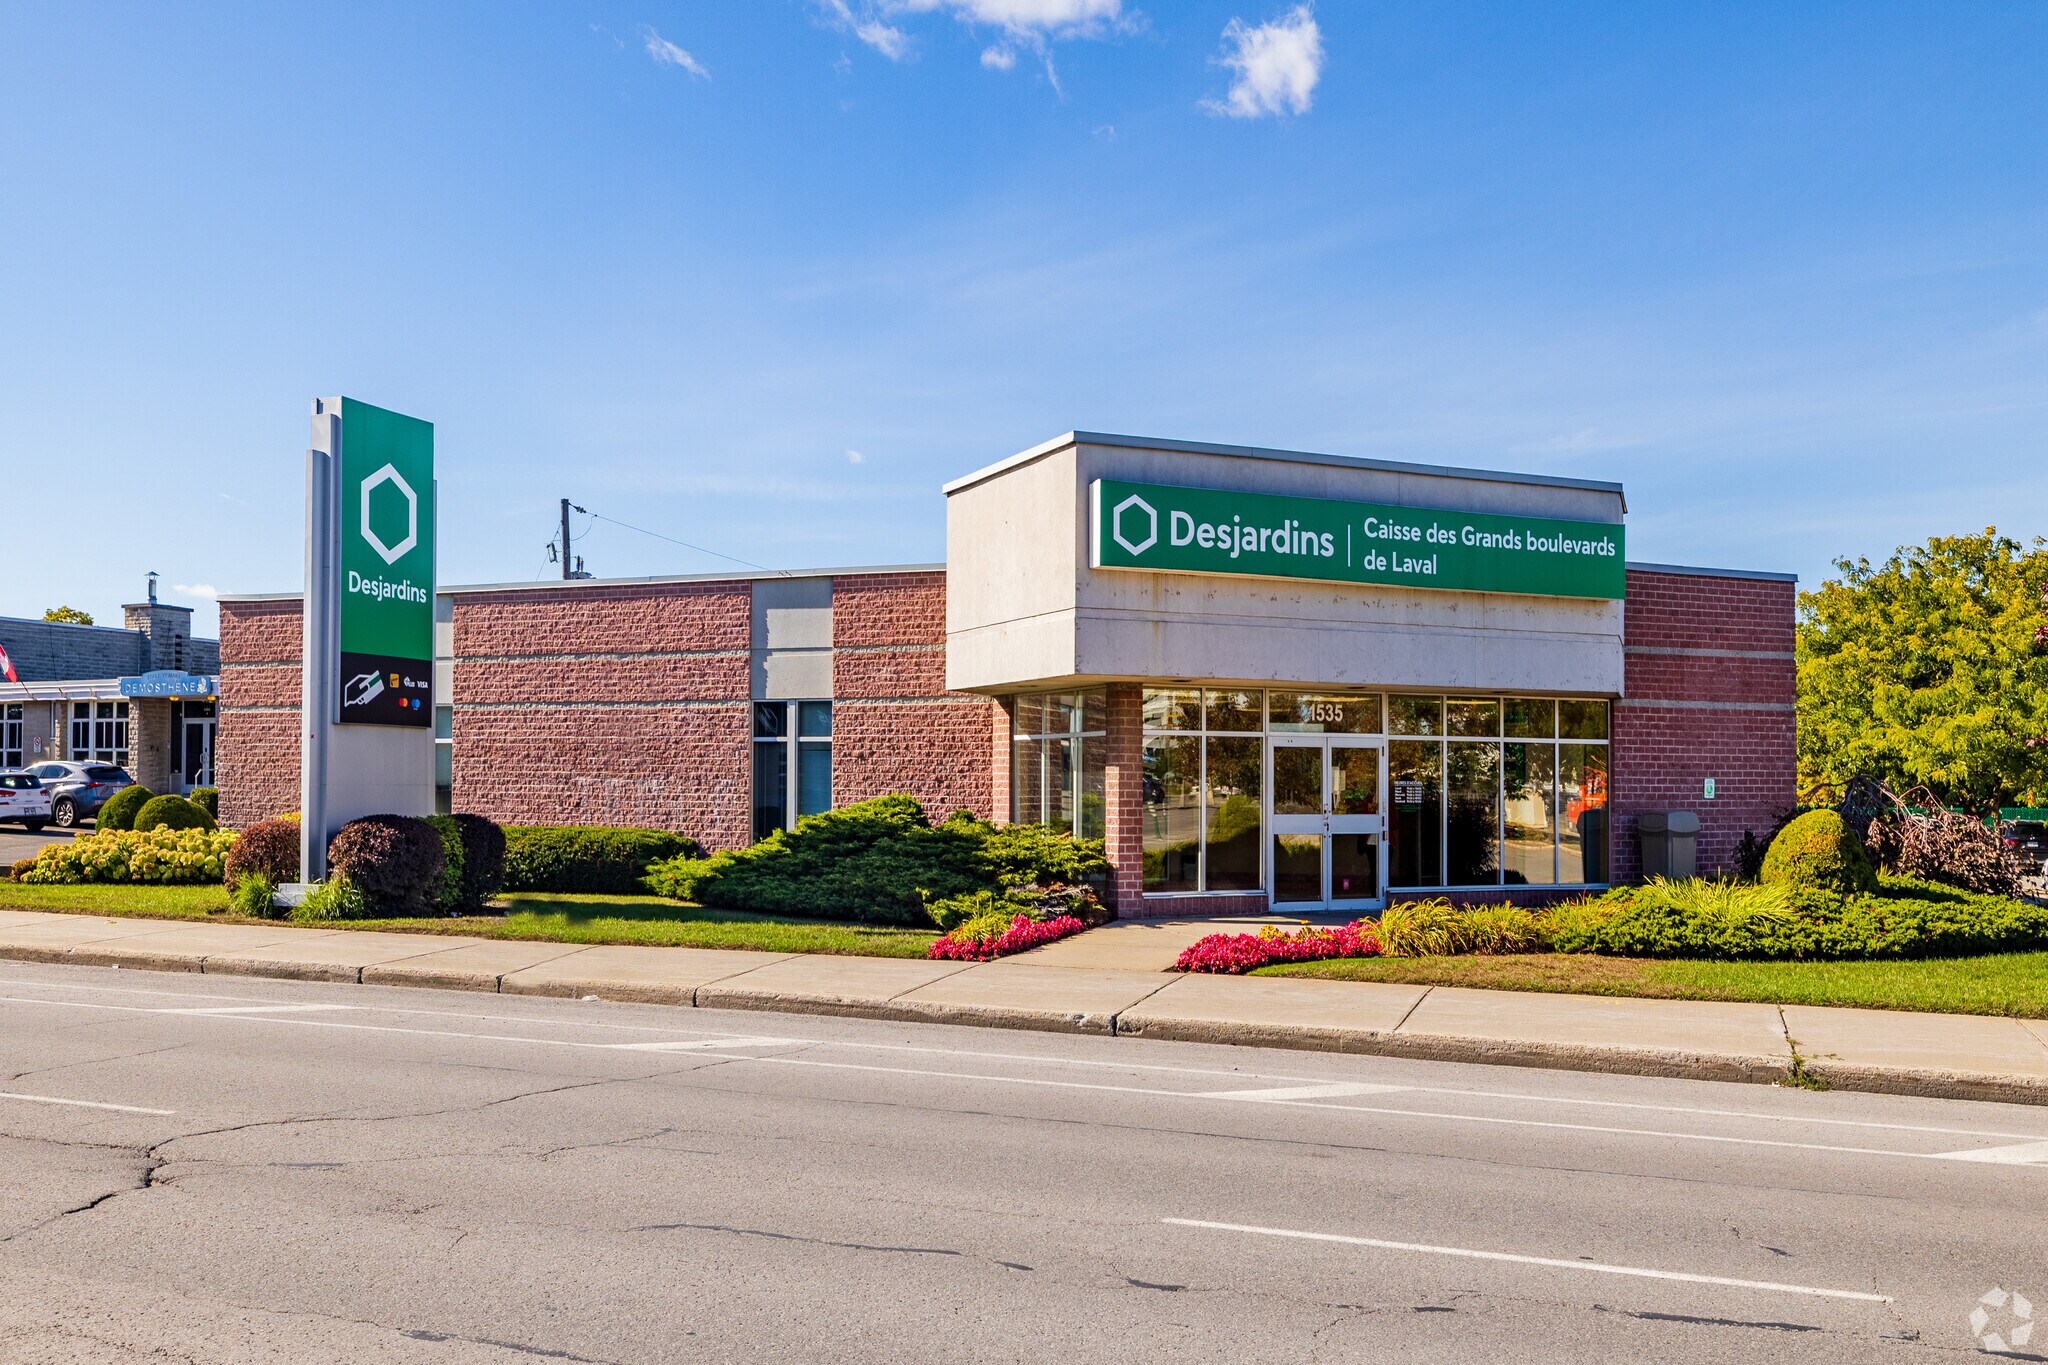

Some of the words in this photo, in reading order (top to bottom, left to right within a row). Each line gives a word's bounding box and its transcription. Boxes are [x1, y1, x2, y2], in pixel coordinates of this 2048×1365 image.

[1170, 509, 1334, 558] Desjardins
[1364, 517, 1422, 544] Caisse
[1425, 521, 1457, 545] des
[1461, 526, 1522, 550] Grands
[1526, 530, 1616, 557] boulevards
[1364, 550, 1388, 571] de
[1392, 552, 1437, 575] Laval
[348, 570, 427, 603] Desjardins
[416, 680, 429, 689] VISA
[1309, 703, 1343, 722] 1535
